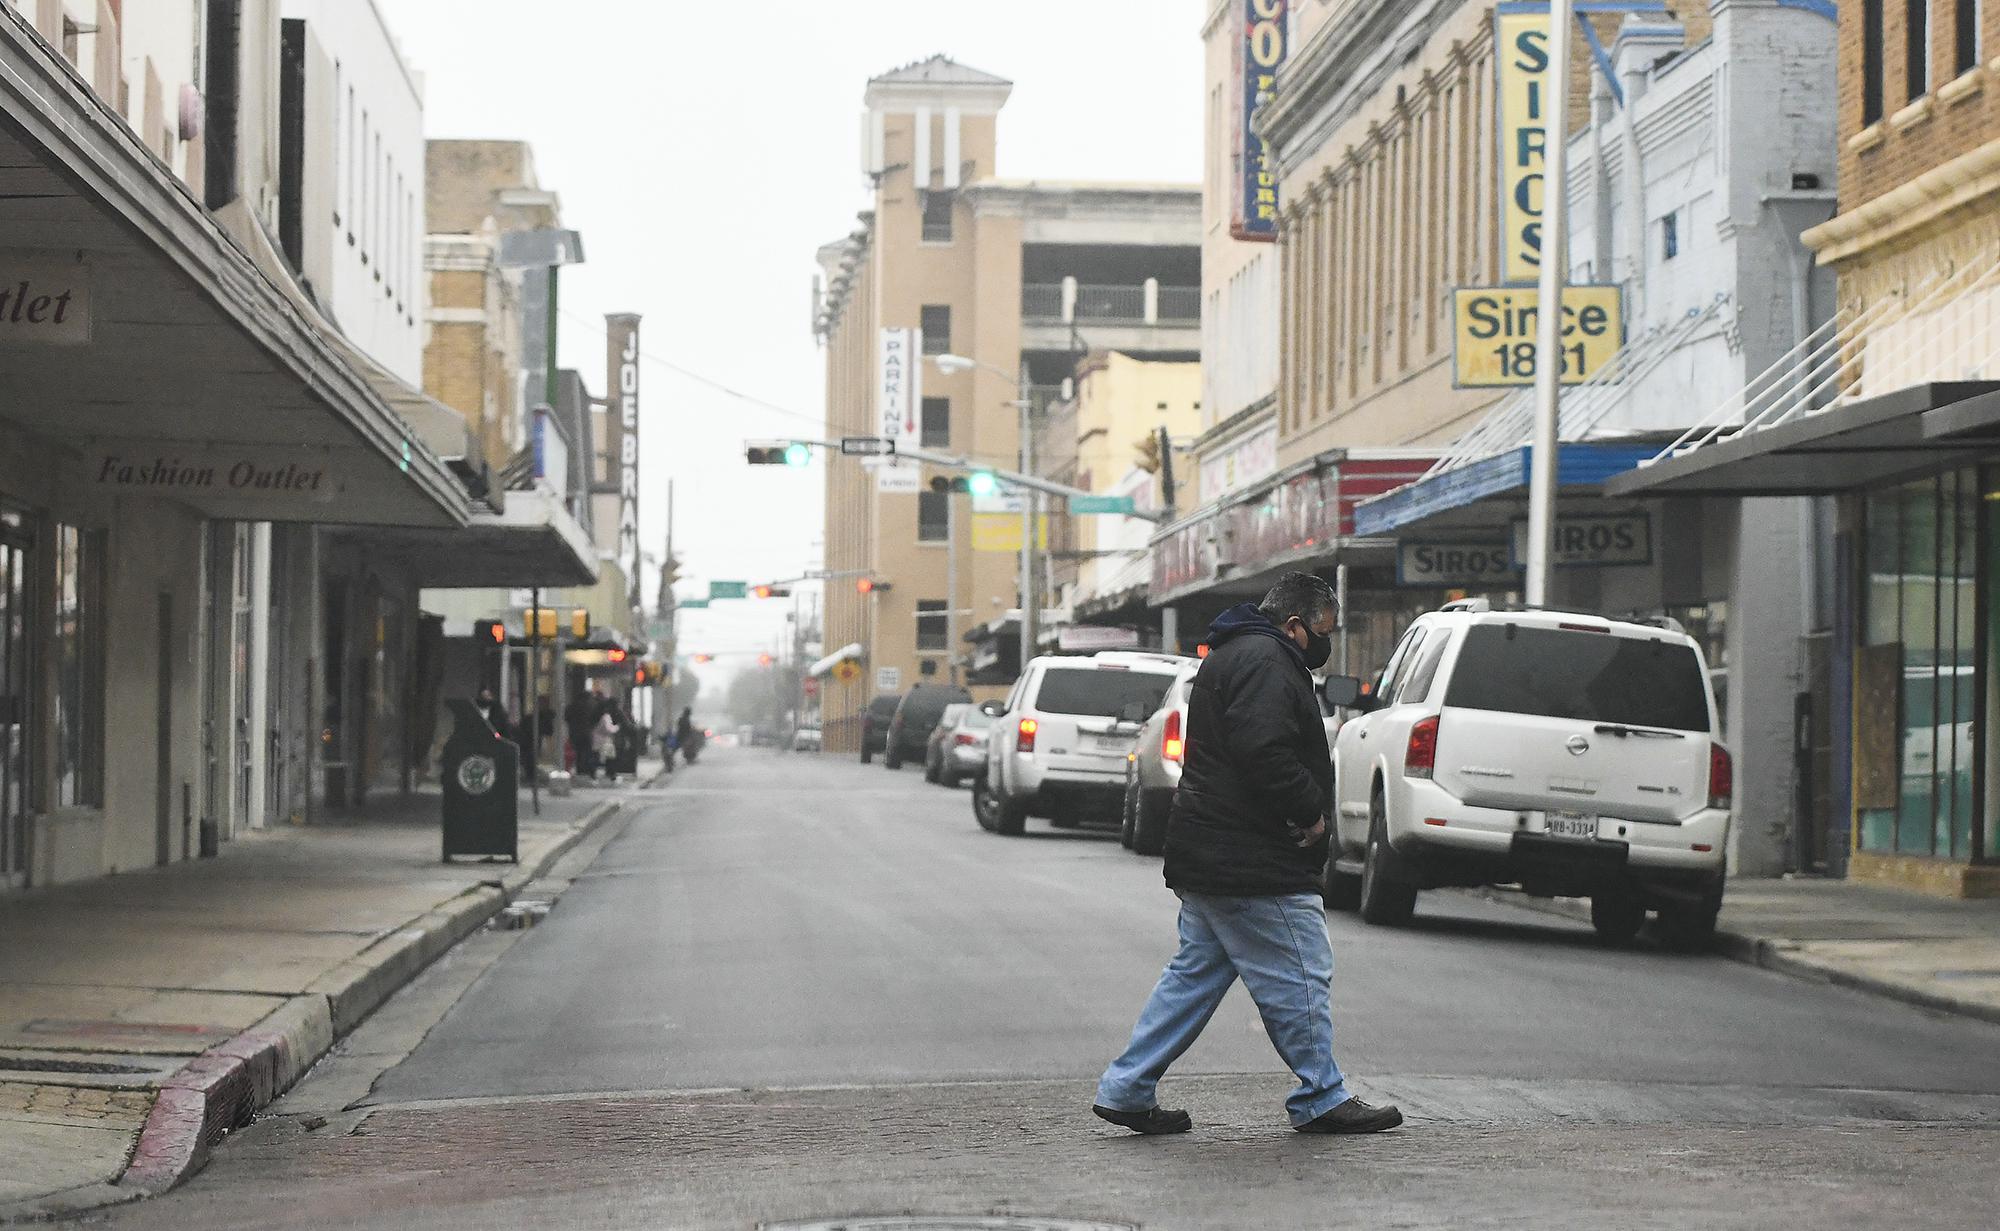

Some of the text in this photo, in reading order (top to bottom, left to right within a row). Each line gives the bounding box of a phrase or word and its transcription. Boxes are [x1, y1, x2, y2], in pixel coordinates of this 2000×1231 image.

[621, 331, 636, 428] JOE
[884, 340, 900, 435] PARKING
[98, 455, 323, 490] Fashion Outlet
[1553, 522, 1635, 551] IROS
